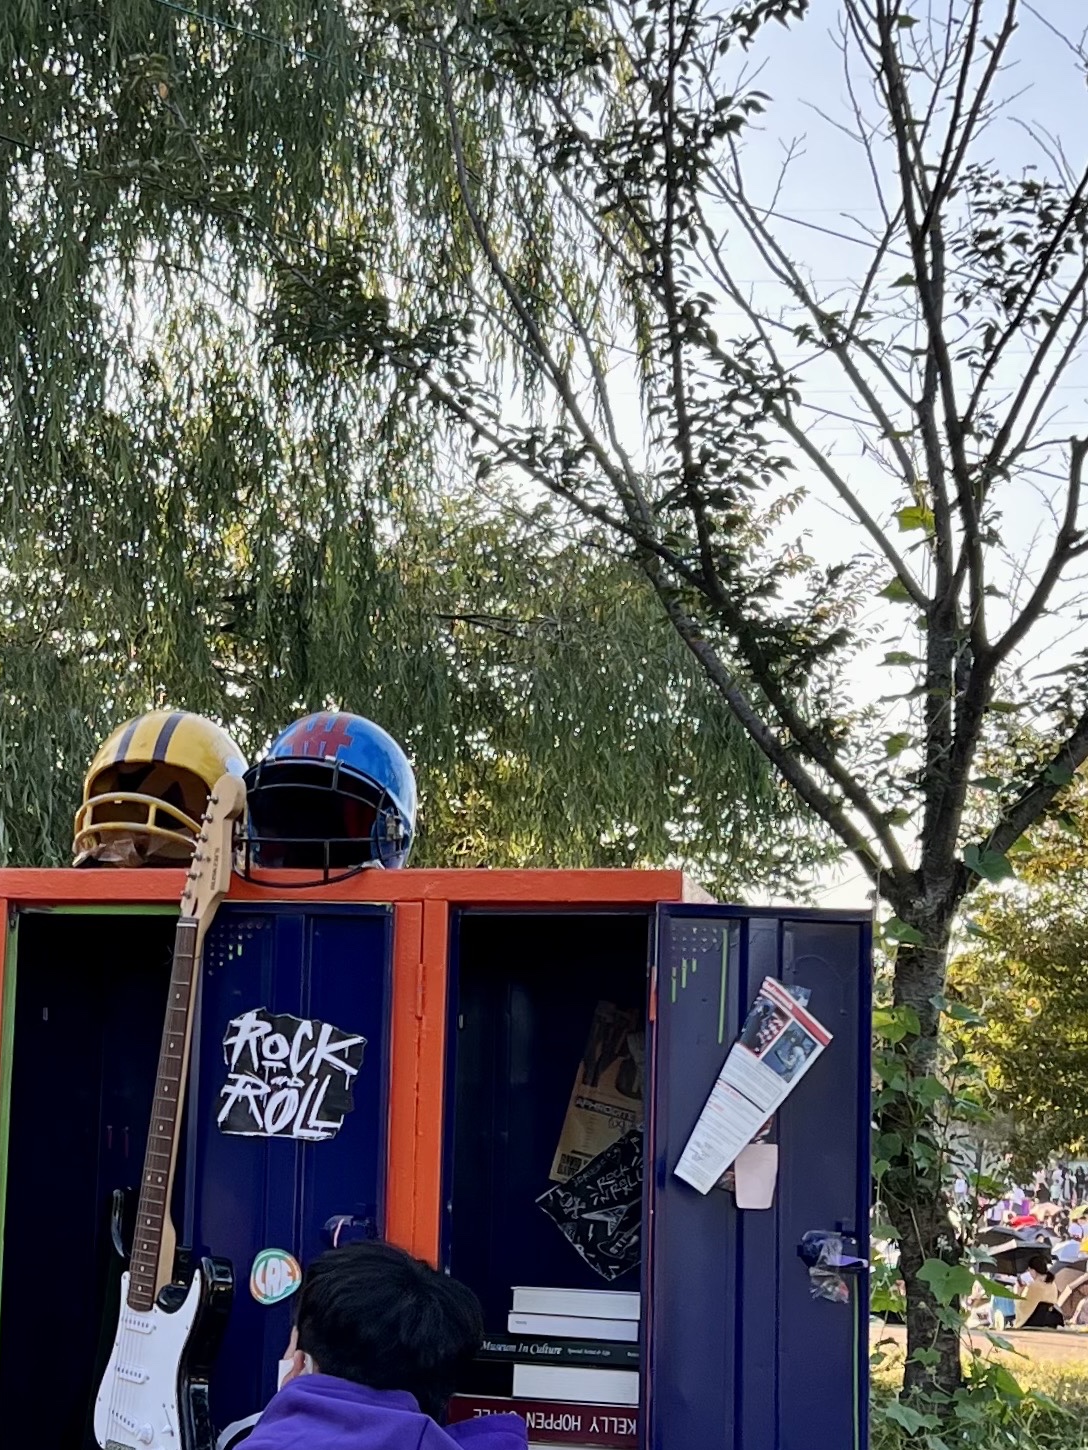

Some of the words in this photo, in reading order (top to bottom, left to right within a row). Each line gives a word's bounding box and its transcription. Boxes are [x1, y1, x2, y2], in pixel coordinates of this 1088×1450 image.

[223, 1011, 365, 1076] ROCK
[217, 1073, 345, 1138] ROLL
[480, 1340, 517, 1353] Museum
[517, 1342, 529, 1353] In
[529, 1342, 563, 1355] Culture
[526, 1411, 582, 1431] HOPPEN
[589, 1416, 637, 1435] KELLY
